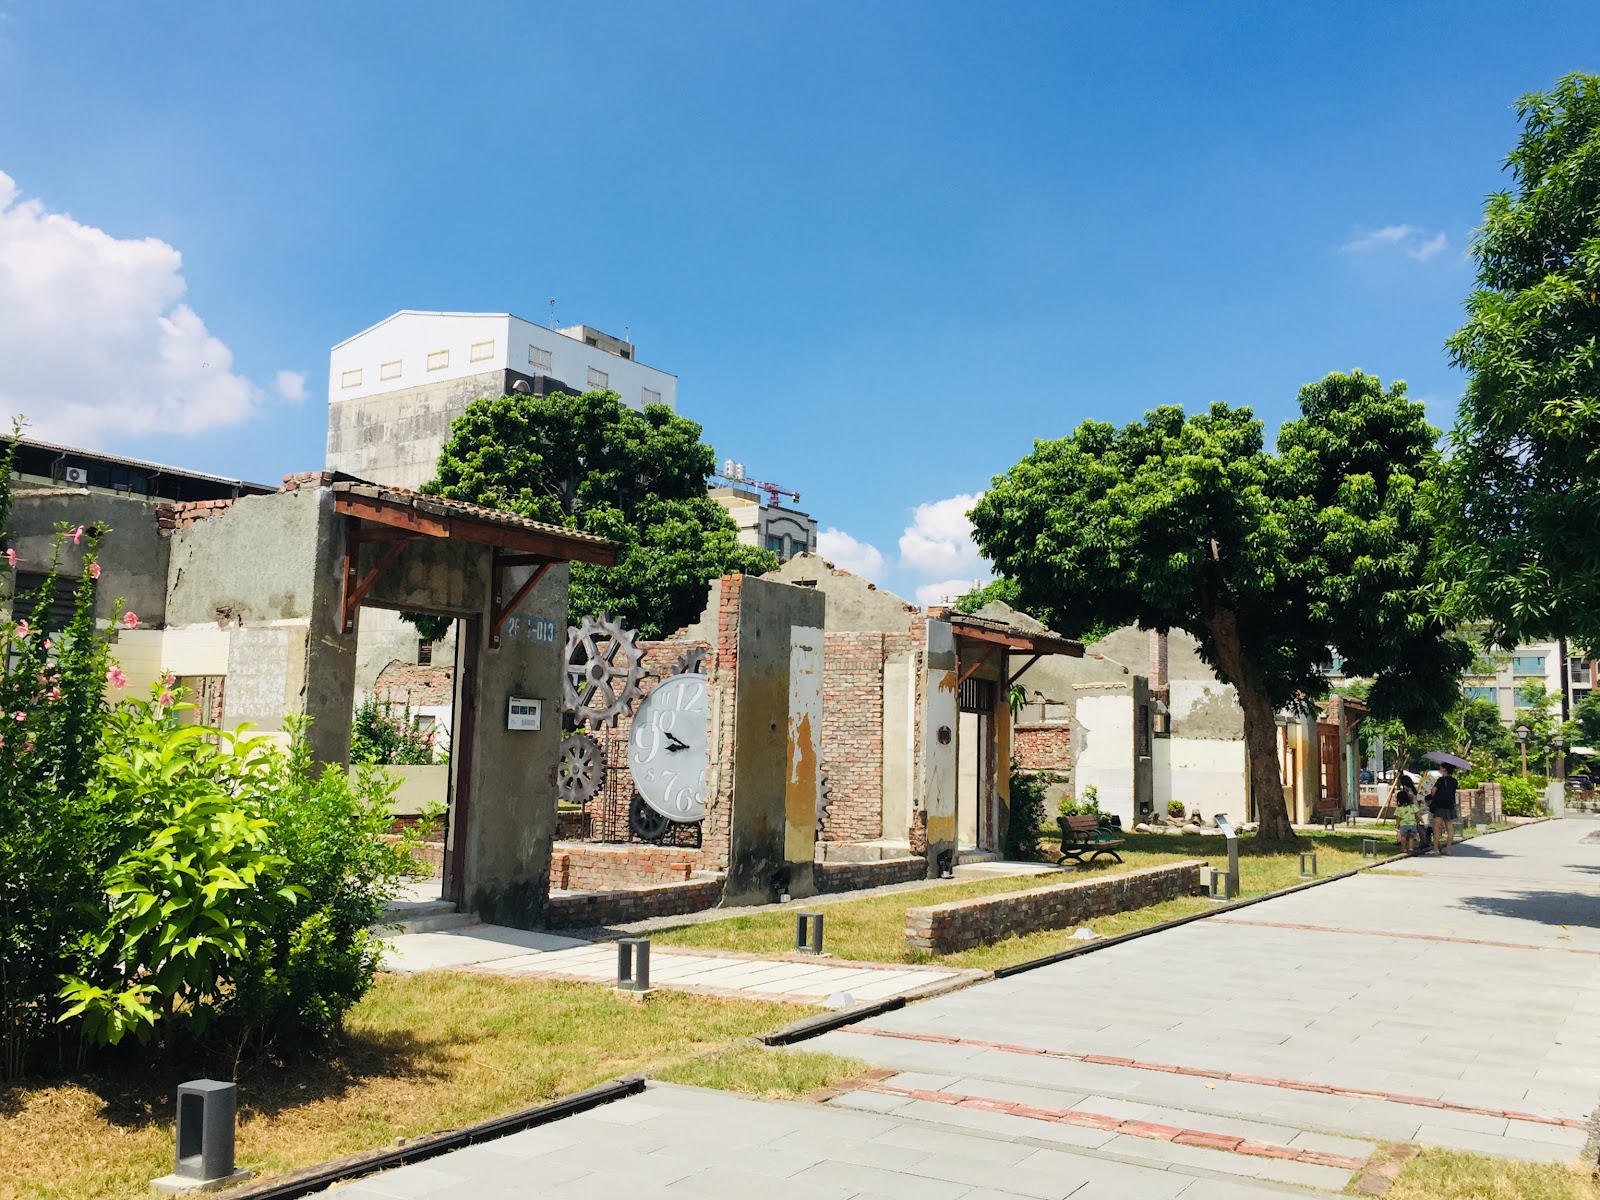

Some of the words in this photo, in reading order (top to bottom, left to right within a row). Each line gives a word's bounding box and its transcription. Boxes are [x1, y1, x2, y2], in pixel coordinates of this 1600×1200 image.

[661, 691, 671, 705] 11
[676, 682, 704, 713] 12
[651, 708, 676, 732] 10
[634, 721, 660, 764] 9
[644, 768, 655, 782] 8
[661, 770, 680, 801] 7
[675, 787, 693, 812] 6
